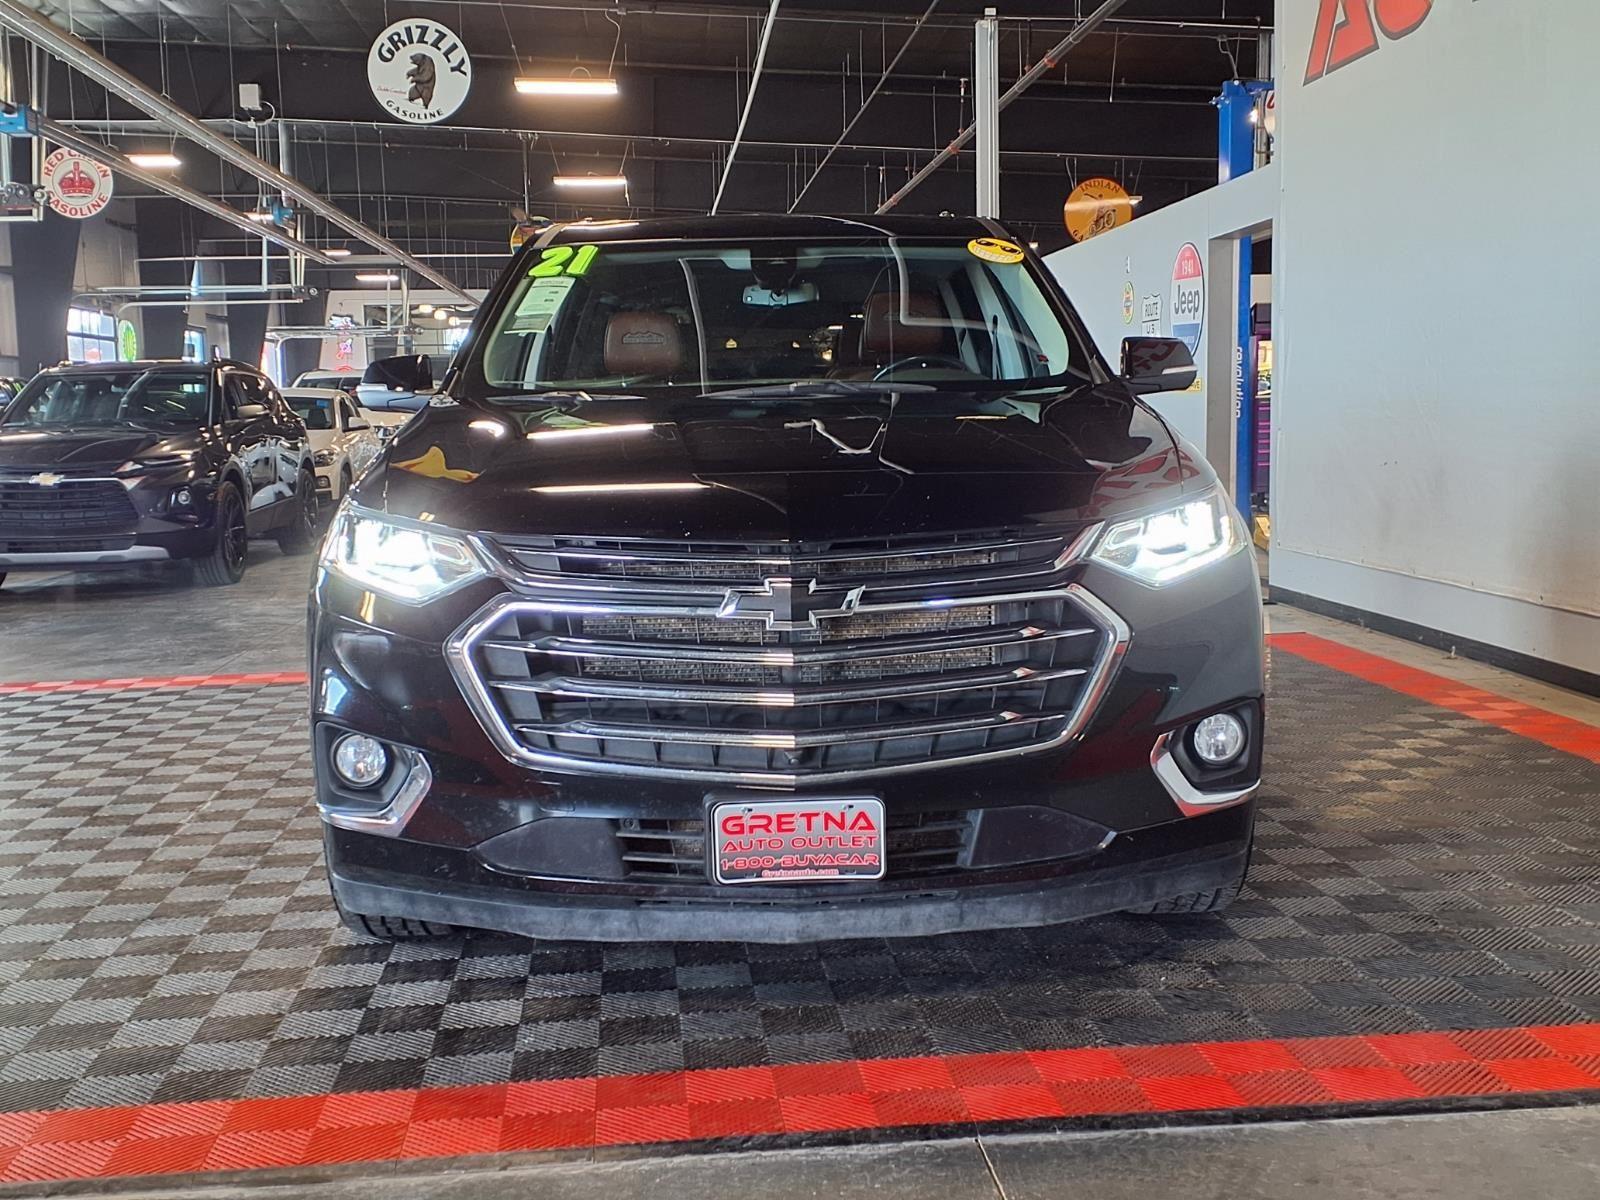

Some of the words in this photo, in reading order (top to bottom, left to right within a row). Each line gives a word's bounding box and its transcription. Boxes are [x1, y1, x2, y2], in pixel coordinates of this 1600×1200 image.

[378, 25, 467, 76] GRIZZLY
[386, 100, 444, 120] GASOLINE
[44, 152, 65, 177] RED
[1080, 180, 1120, 193] INDIAN
[528, 245, 598, 277] 21
[1144, 301, 1159, 317] ROUTE
[1174, 284, 1200, 320] Jeep
[721, 811, 877, 836] GRETNA
[721, 840, 784, 853] AUTO
[791, 835, 878, 848] OUTLET
[720, 853, 880, 871] 1-800-BUYACAR
